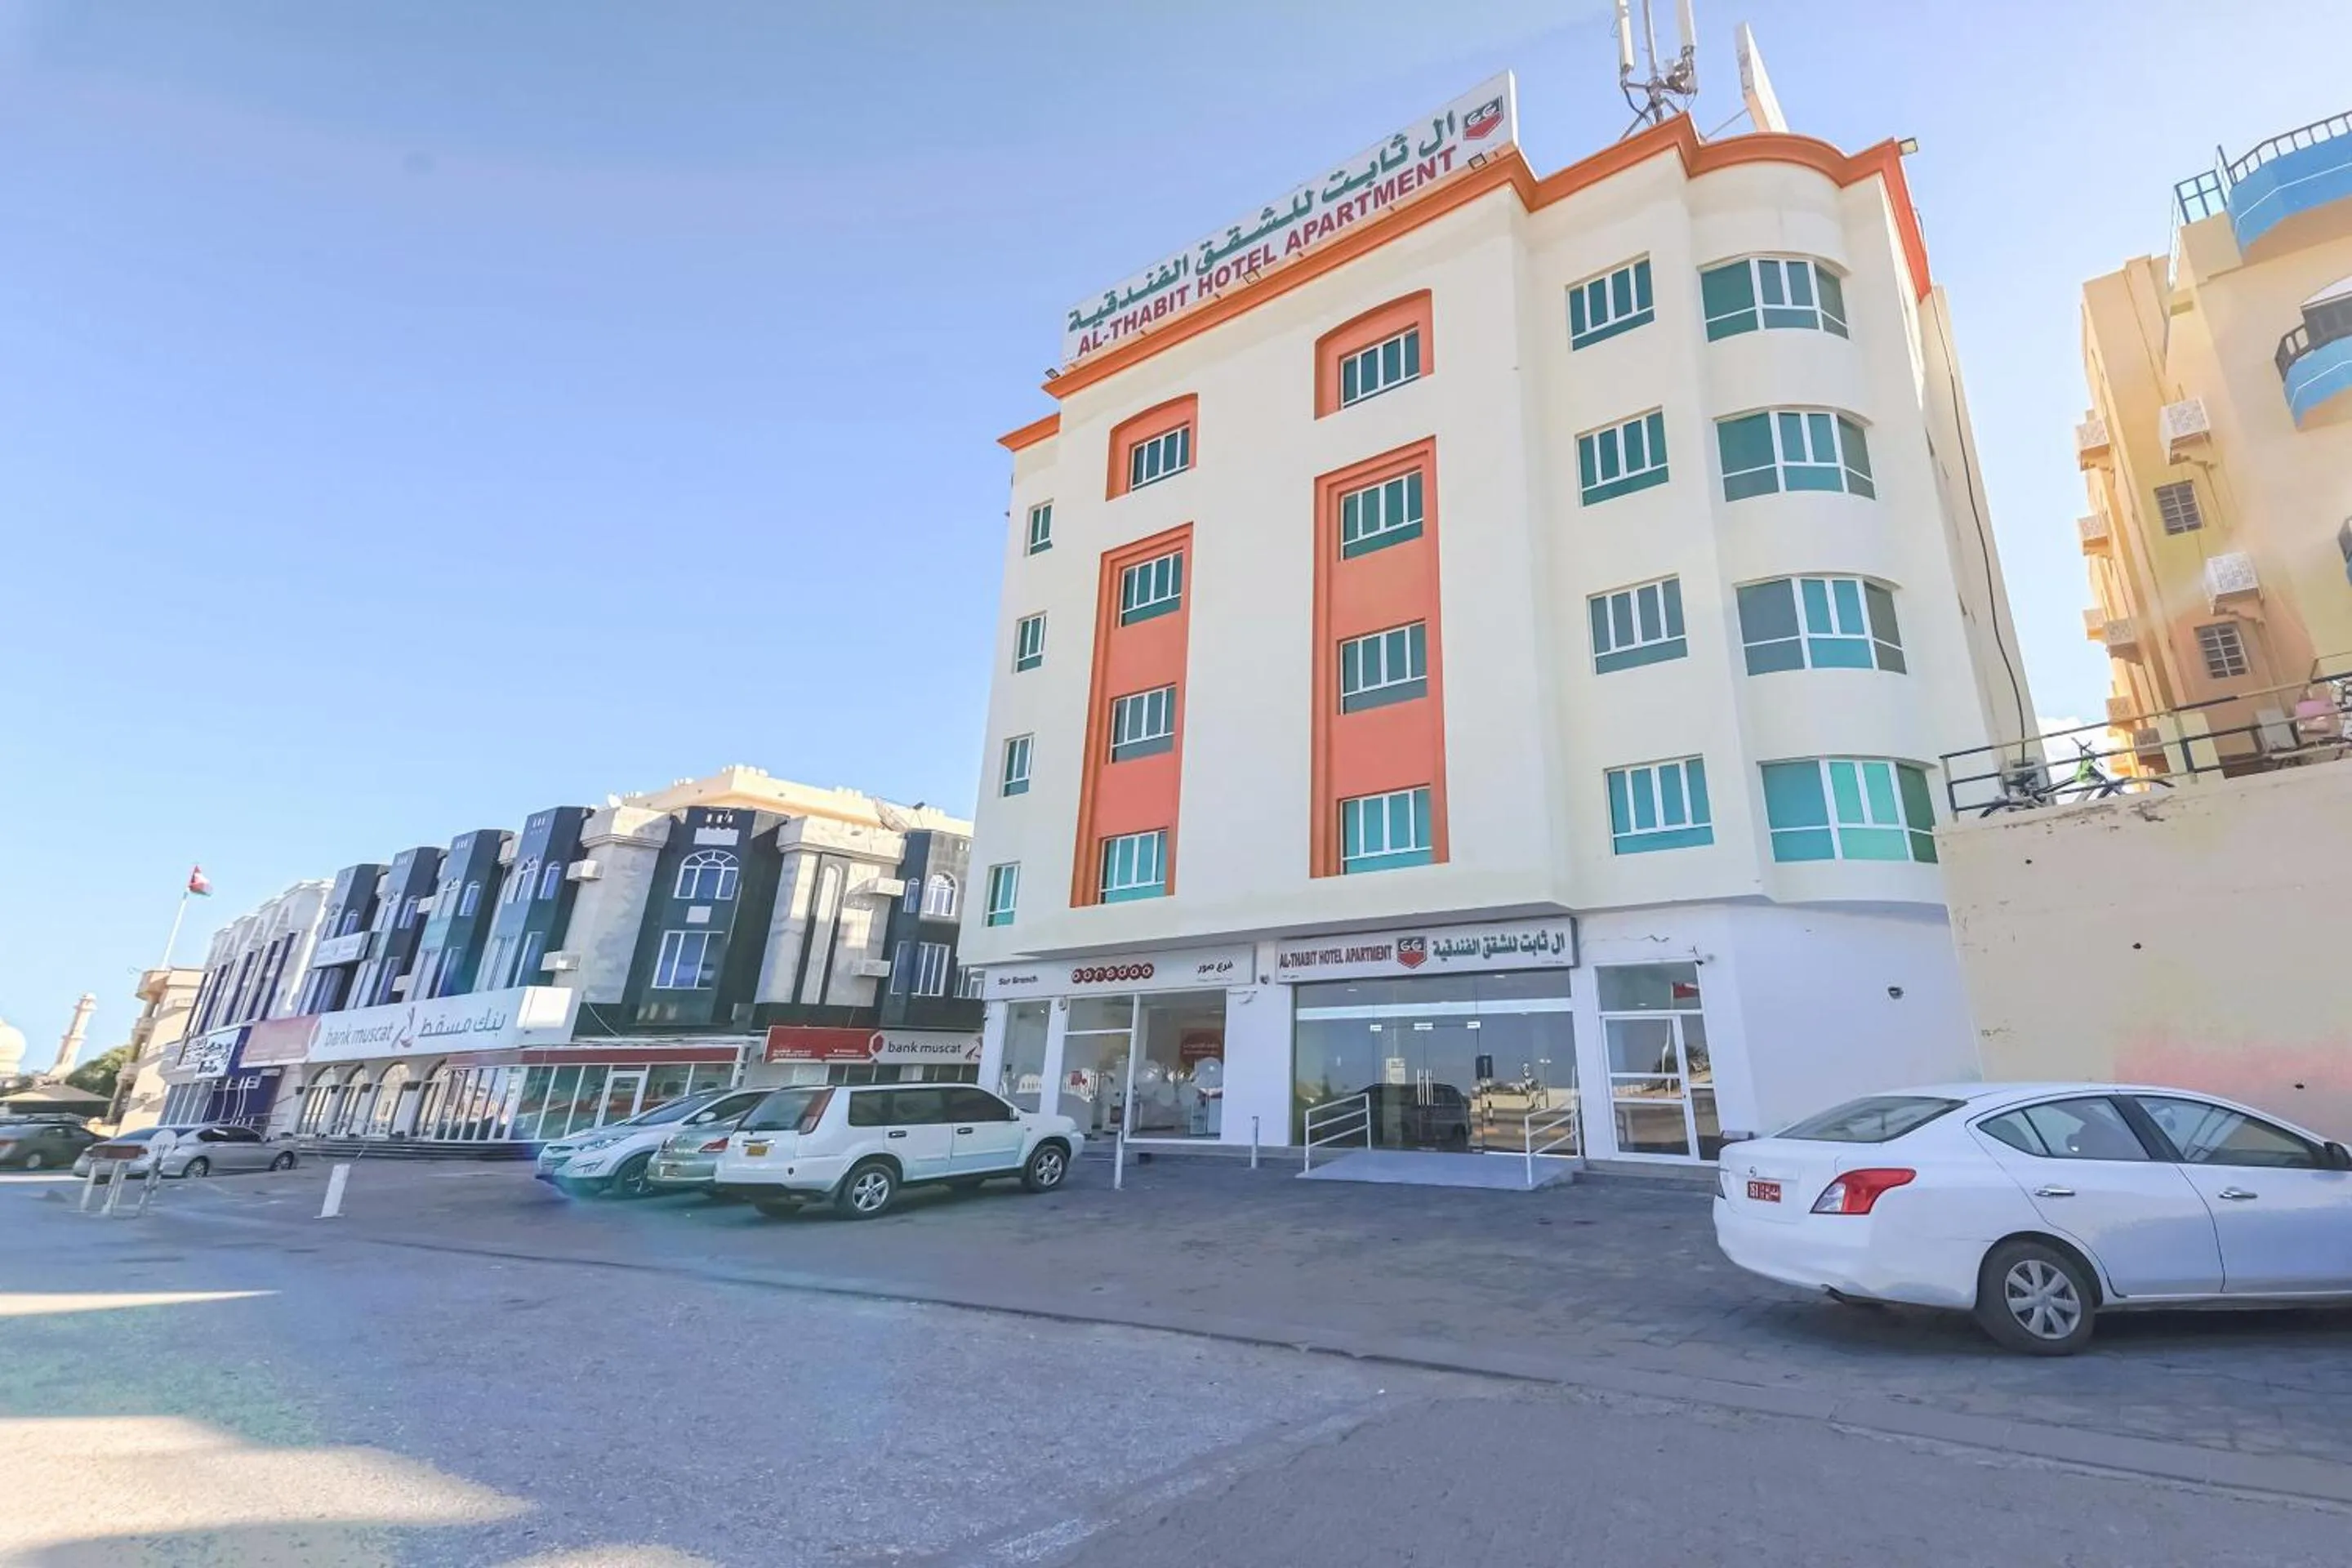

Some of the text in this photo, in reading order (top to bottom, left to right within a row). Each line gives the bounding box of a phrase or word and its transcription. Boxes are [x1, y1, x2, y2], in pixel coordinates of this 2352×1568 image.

[1321, 133, 1410, 203] ثابت
[1196, 189, 1315, 276] للشقق
[1077, 143, 1458, 357] AL-THABIT HOTEL APARTMENT
[1067, 252, 1189, 332] الفندقية
[1279, 944, 1392, 969] AL-THABIT HOTEL APARTMENT
[1432, 938, 1481, 962] الفندقية
[1482, 933, 1518, 960] للشقق
[1519, 929, 1548, 957] ثابت
[1071, 962, 1155, 984] ooredoo
[325, 1022, 394, 1046] bank muscat
[418, 1007, 507, 1039] بنك مسقط
[888, 1040, 962, 1054] bank muscat
